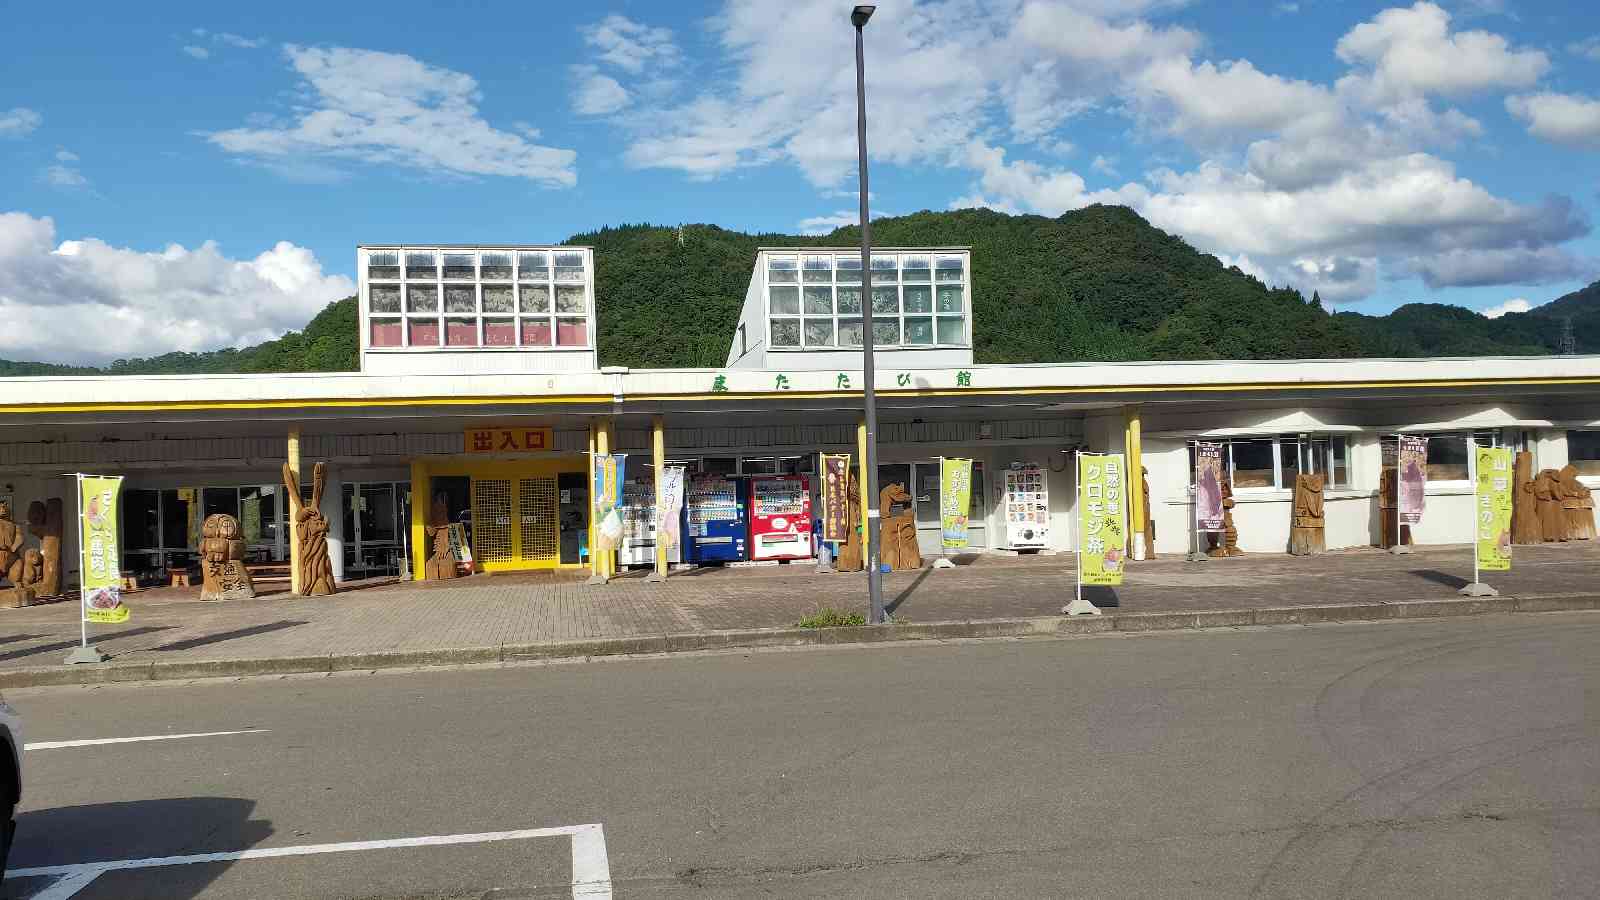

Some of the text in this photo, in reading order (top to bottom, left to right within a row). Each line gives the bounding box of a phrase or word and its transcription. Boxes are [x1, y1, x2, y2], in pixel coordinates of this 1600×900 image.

[473, 431, 545, 450] 出入口
[1087, 464, 1105, 555] クロモジ茶
